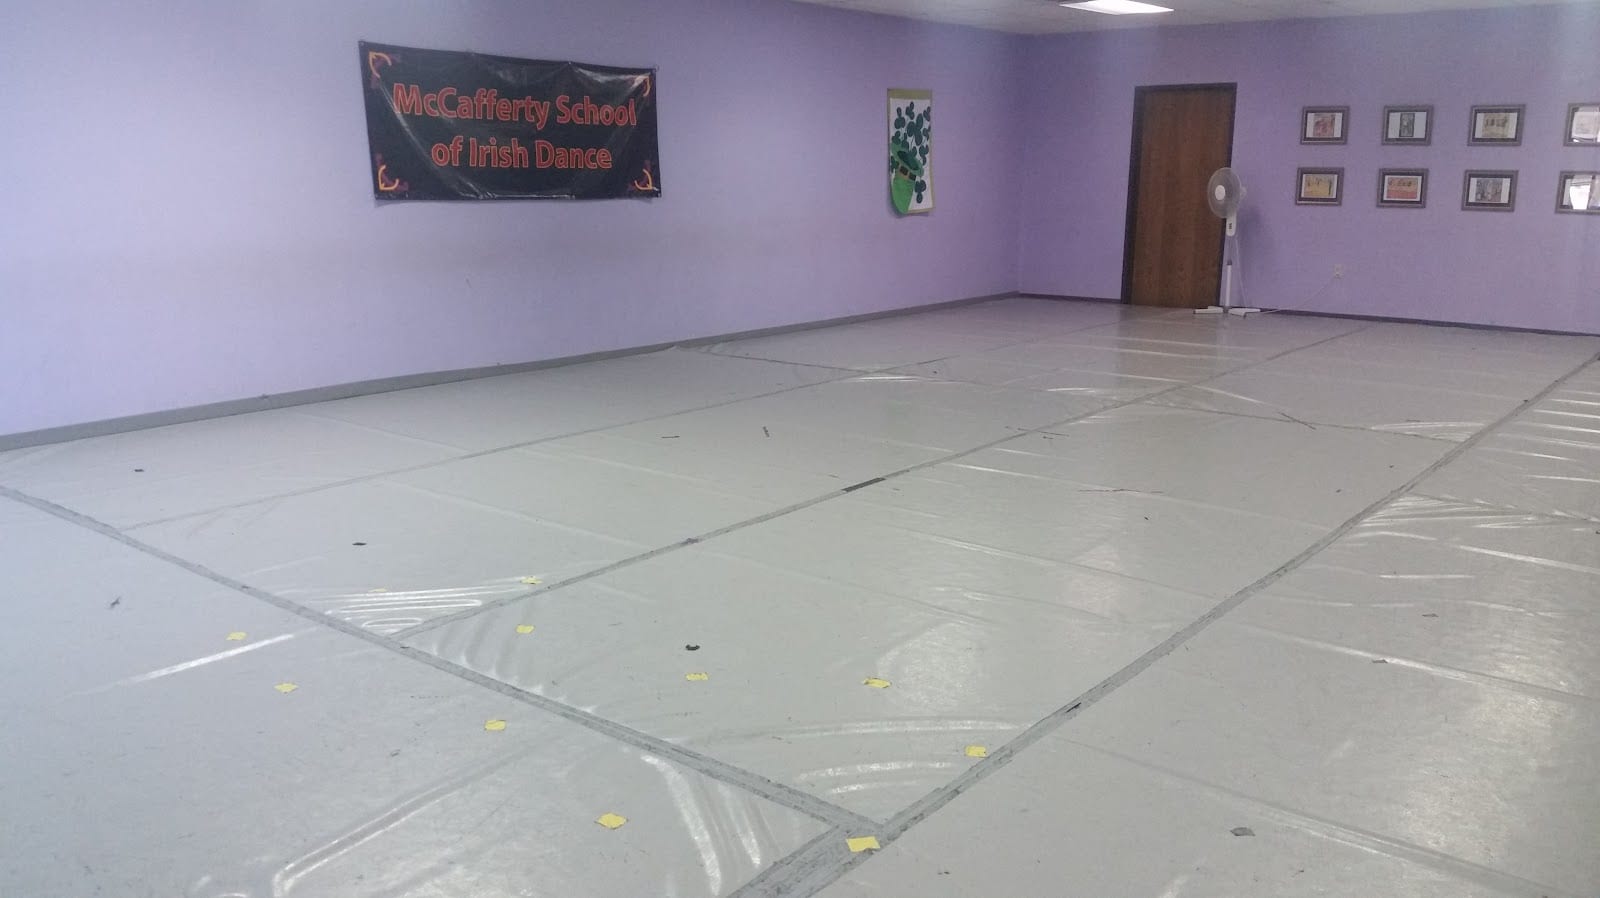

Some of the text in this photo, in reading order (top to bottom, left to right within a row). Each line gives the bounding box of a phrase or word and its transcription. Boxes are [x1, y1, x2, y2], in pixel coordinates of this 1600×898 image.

[393, 83, 637, 130] McCafferty School
[431, 135, 612, 169] of Irish Dance
